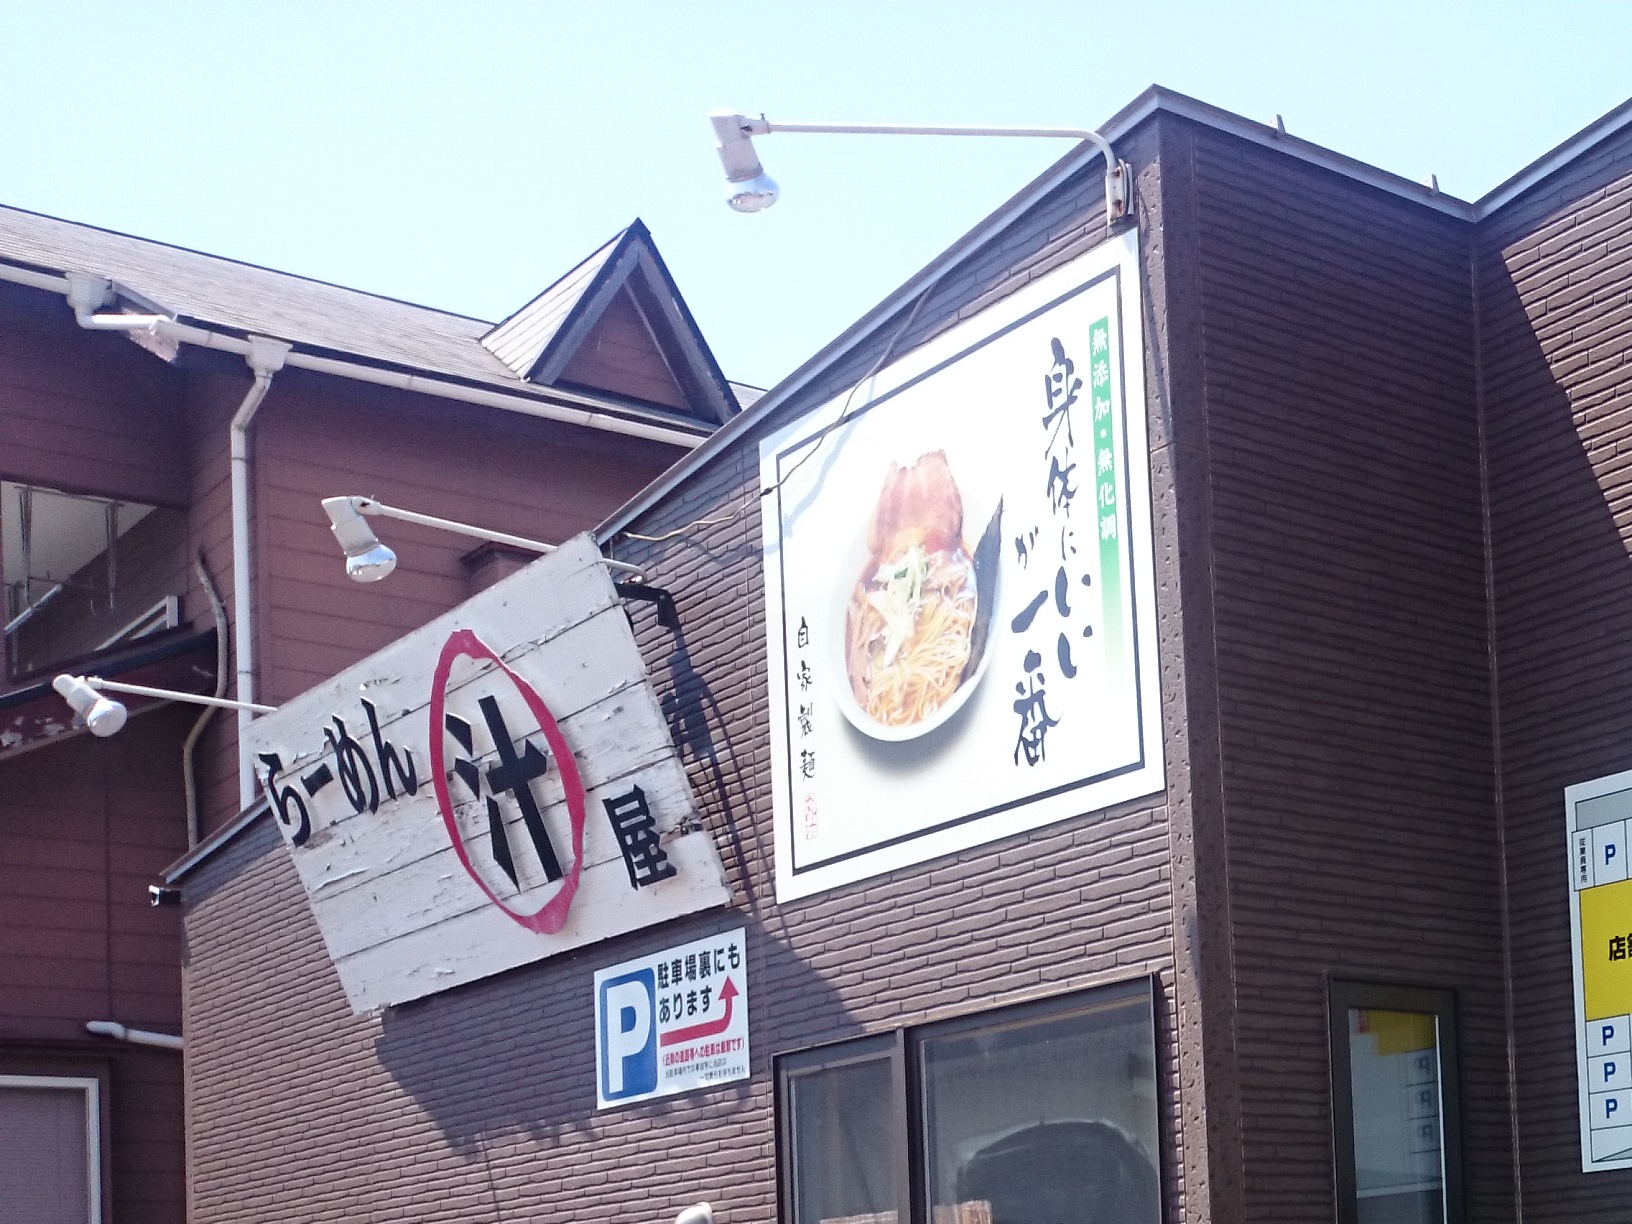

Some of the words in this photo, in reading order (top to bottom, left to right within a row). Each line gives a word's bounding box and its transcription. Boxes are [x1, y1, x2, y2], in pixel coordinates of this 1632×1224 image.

[797, 616, 817, 781] 自家製麺
[1578, 837, 1588, 883] 従業員専用
[1604, 844, 1617, 866] P
[656, 942, 741, 991] 駐車場裏にも
[658, 985, 713, 1025] あります
[606, 980, 651, 1094] P
[1602, 1024, 1616, 1047] P
[1603, 1061, 1617, 1083] P
[1605, 1098, 1619, 1120] P
